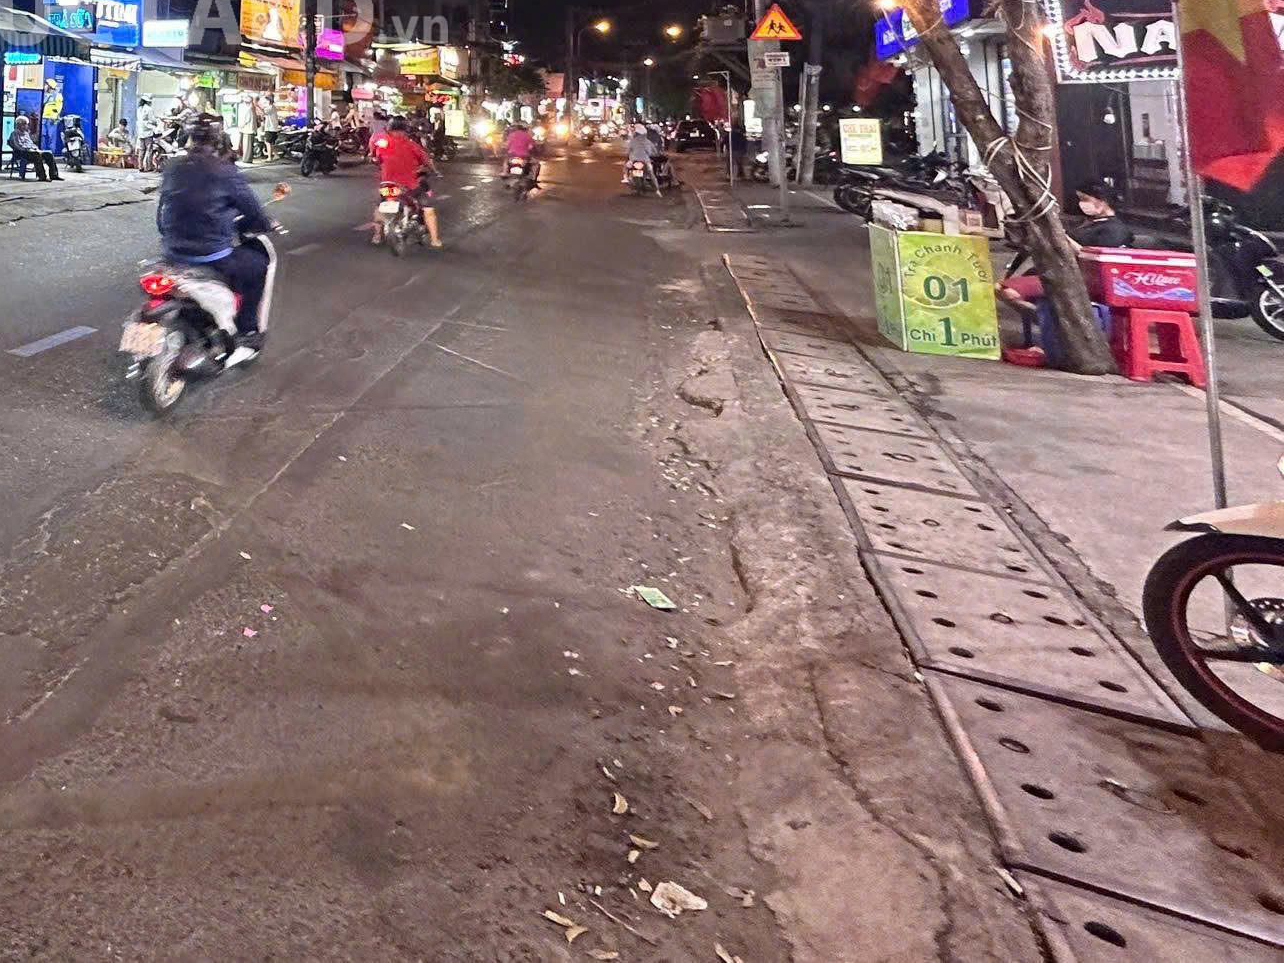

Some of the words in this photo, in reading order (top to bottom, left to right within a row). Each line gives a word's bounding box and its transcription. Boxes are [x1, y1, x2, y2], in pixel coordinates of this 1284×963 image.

[914, 244, 963, 259] Chanh
[923, 275, 970, 302] 01
[938, 316, 958, 347] 1
